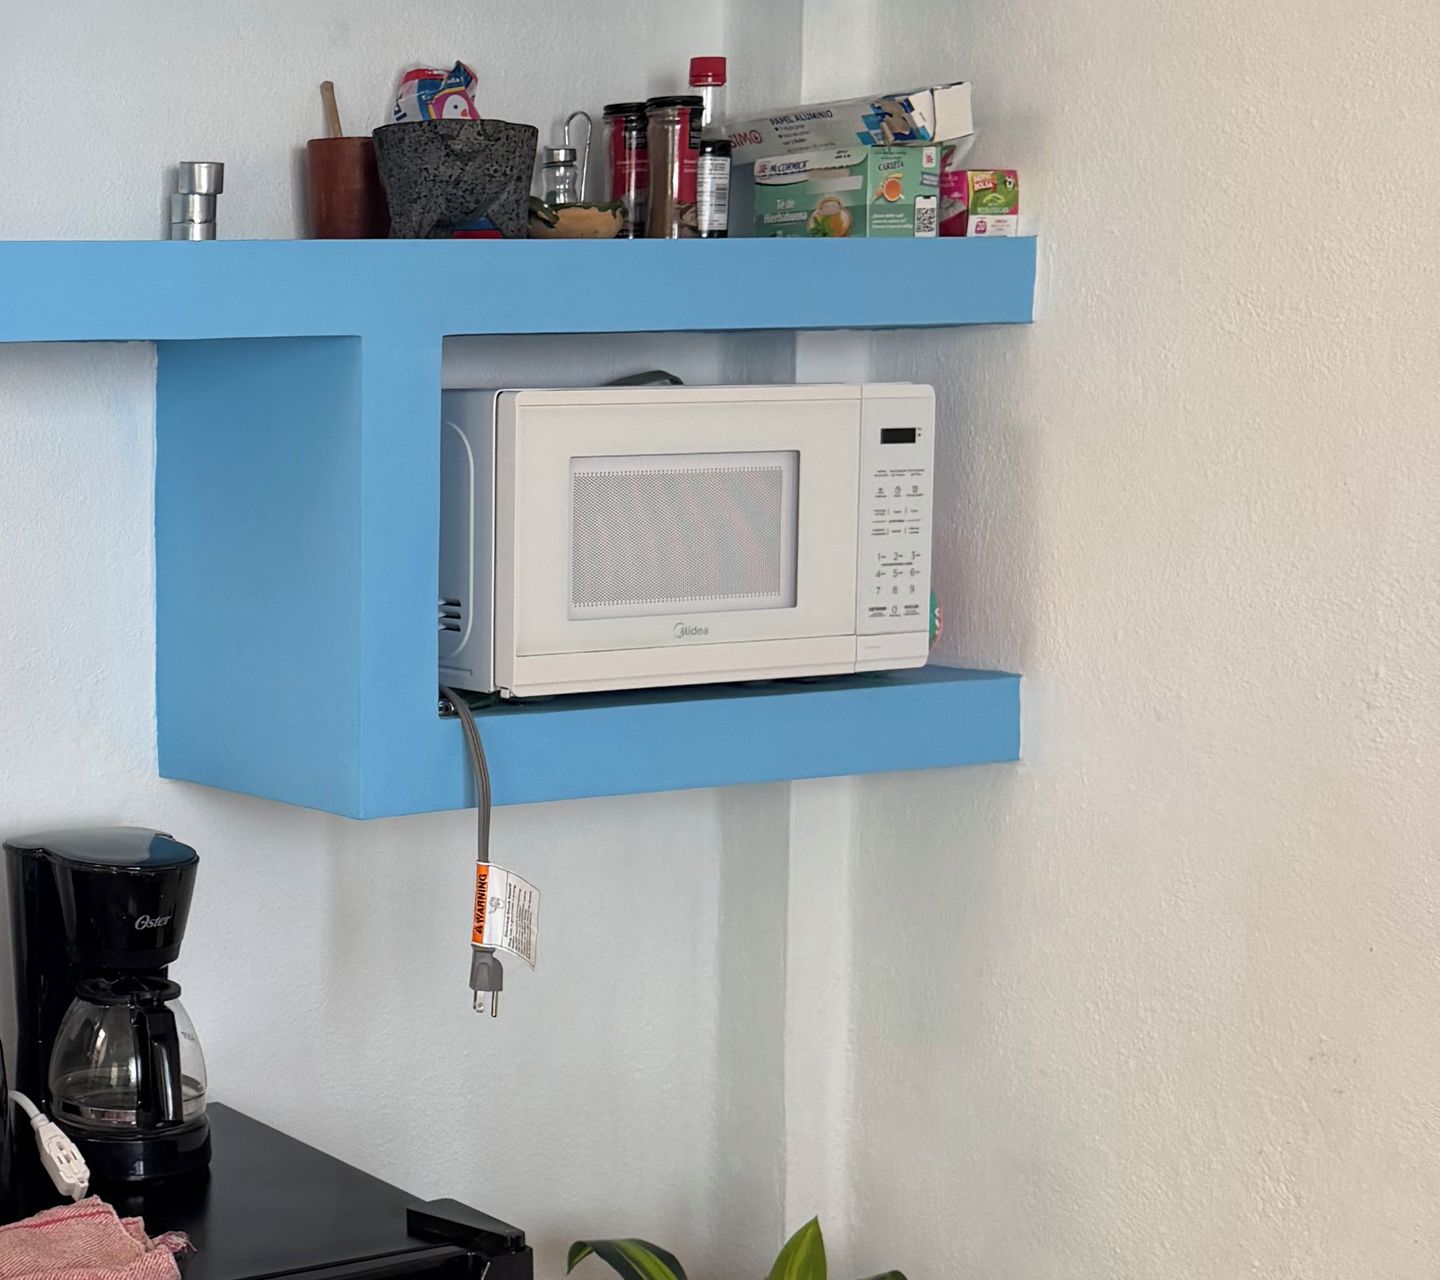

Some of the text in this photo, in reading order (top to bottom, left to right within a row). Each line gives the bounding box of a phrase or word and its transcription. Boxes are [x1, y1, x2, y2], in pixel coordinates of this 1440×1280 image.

[769, 110, 833, 126] PAPEL ALUMINIO
[673, 622, 709, 639] Midea
[476, 873, 488, 924] WARNING
[134, 914, 172, 931] Oster
